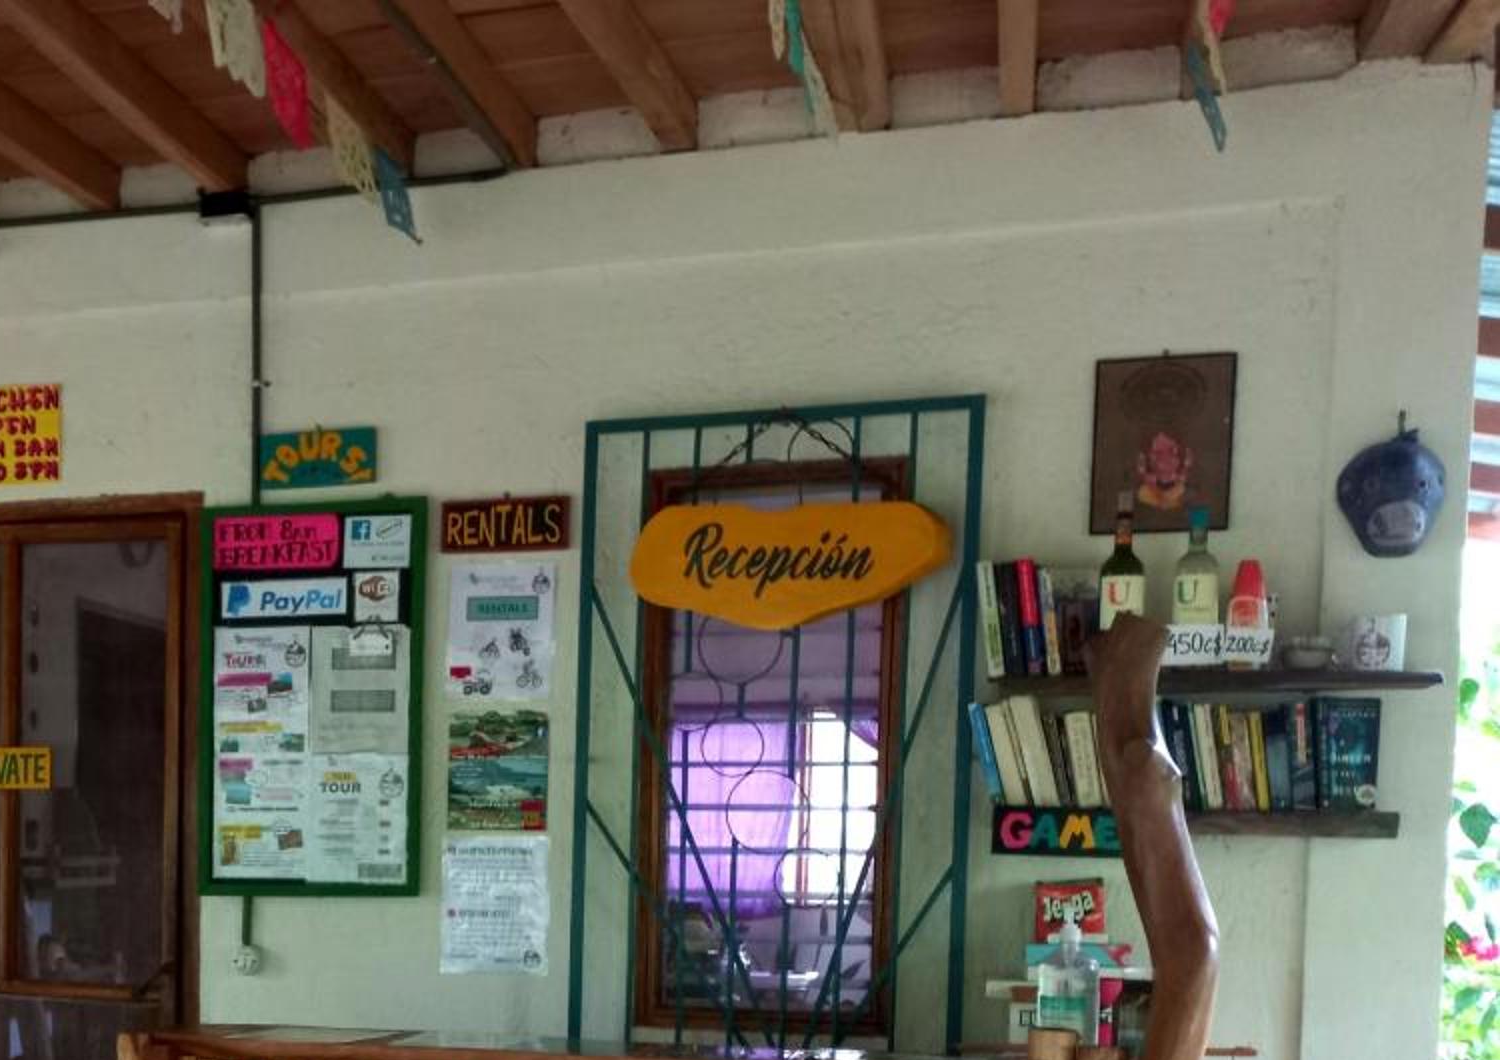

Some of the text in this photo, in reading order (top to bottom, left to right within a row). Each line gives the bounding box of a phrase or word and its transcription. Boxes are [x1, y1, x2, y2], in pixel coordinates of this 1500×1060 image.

[263, 431, 373, 481] TOURS
[447, 504, 561, 547] RENTALS
[218, 541, 335, 567] BREAKFAST
[684, 522, 874, 598] Recepción
[260, 588, 342, 613] PayPal
[319, 780, 362, 794] TOUR
